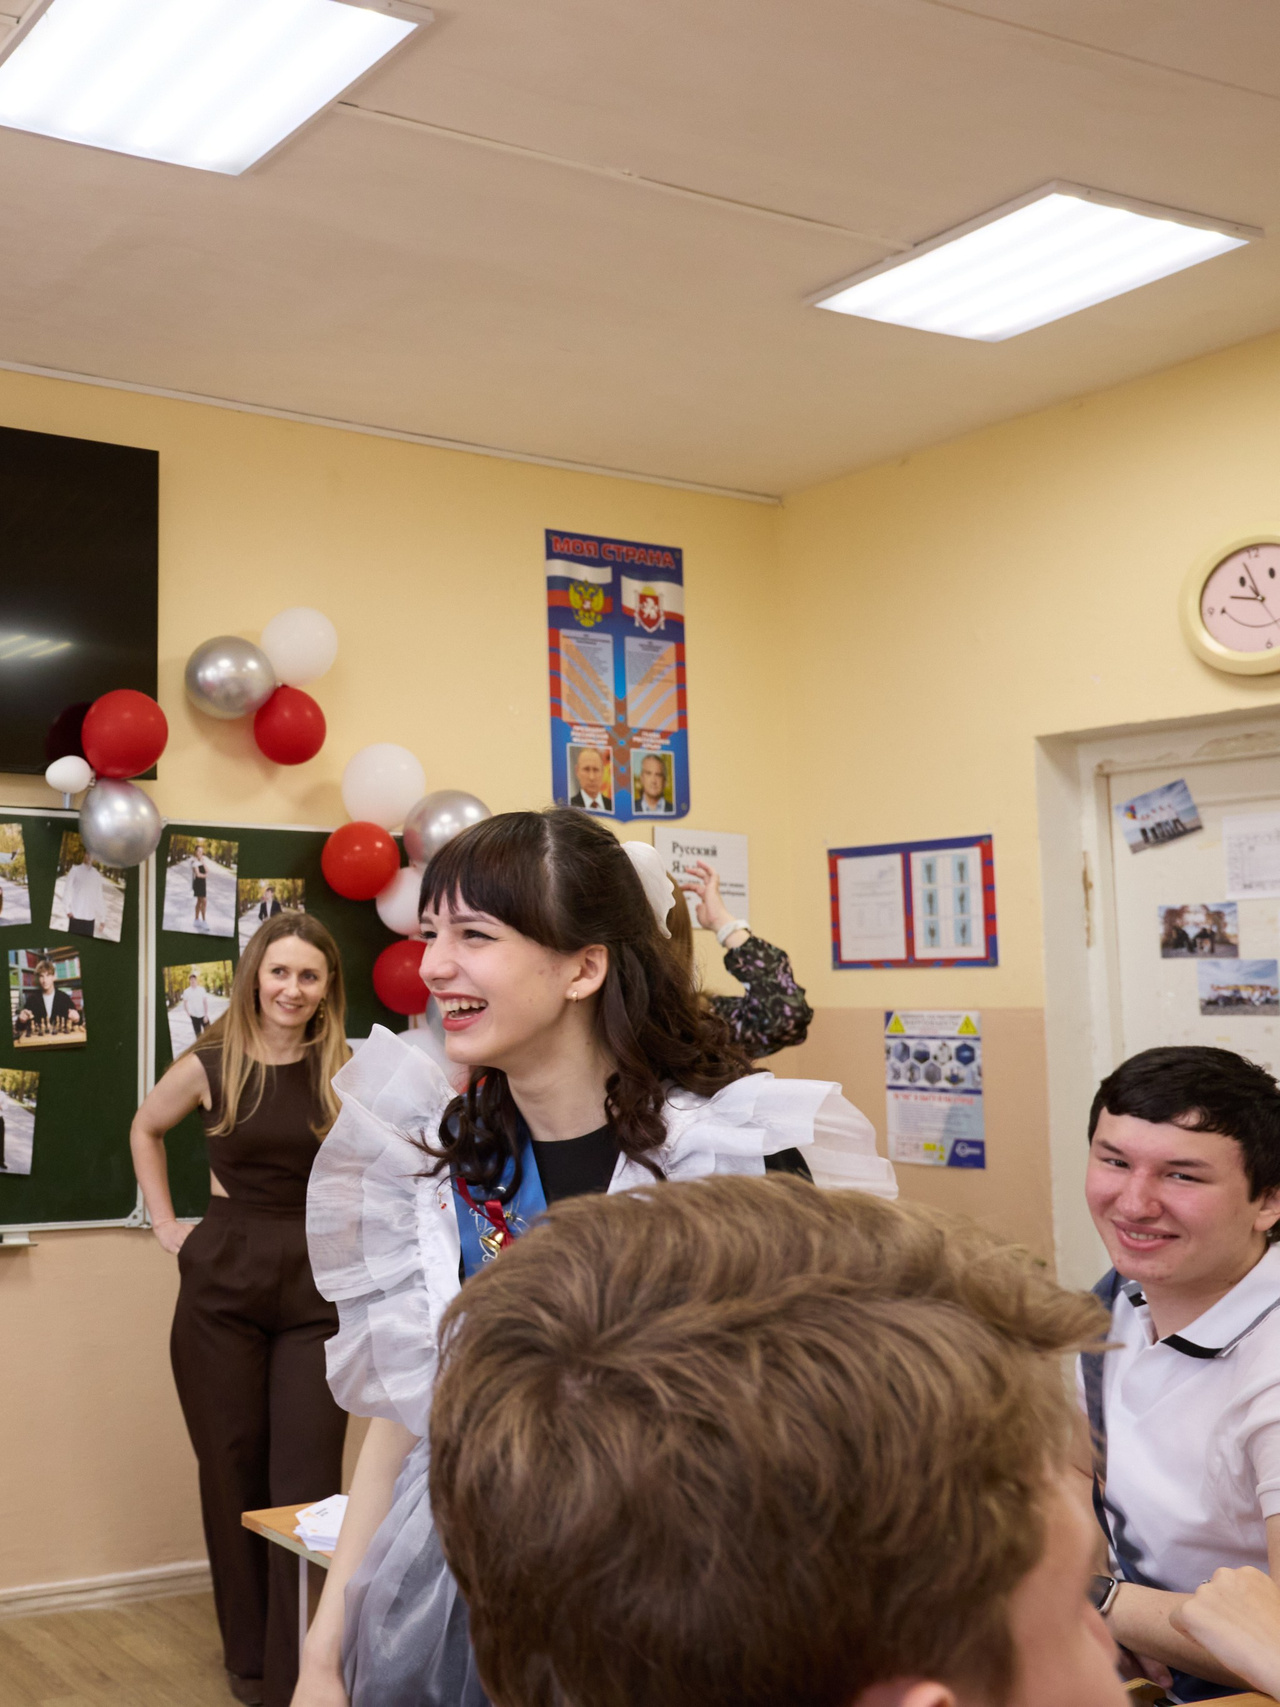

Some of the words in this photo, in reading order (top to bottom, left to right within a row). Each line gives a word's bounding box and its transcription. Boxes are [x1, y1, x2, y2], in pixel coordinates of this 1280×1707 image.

[551, 536, 599, 558] МОЯ
[601, 542, 676, 569] СТРАНА
[671, 841, 717, 857] Русский
